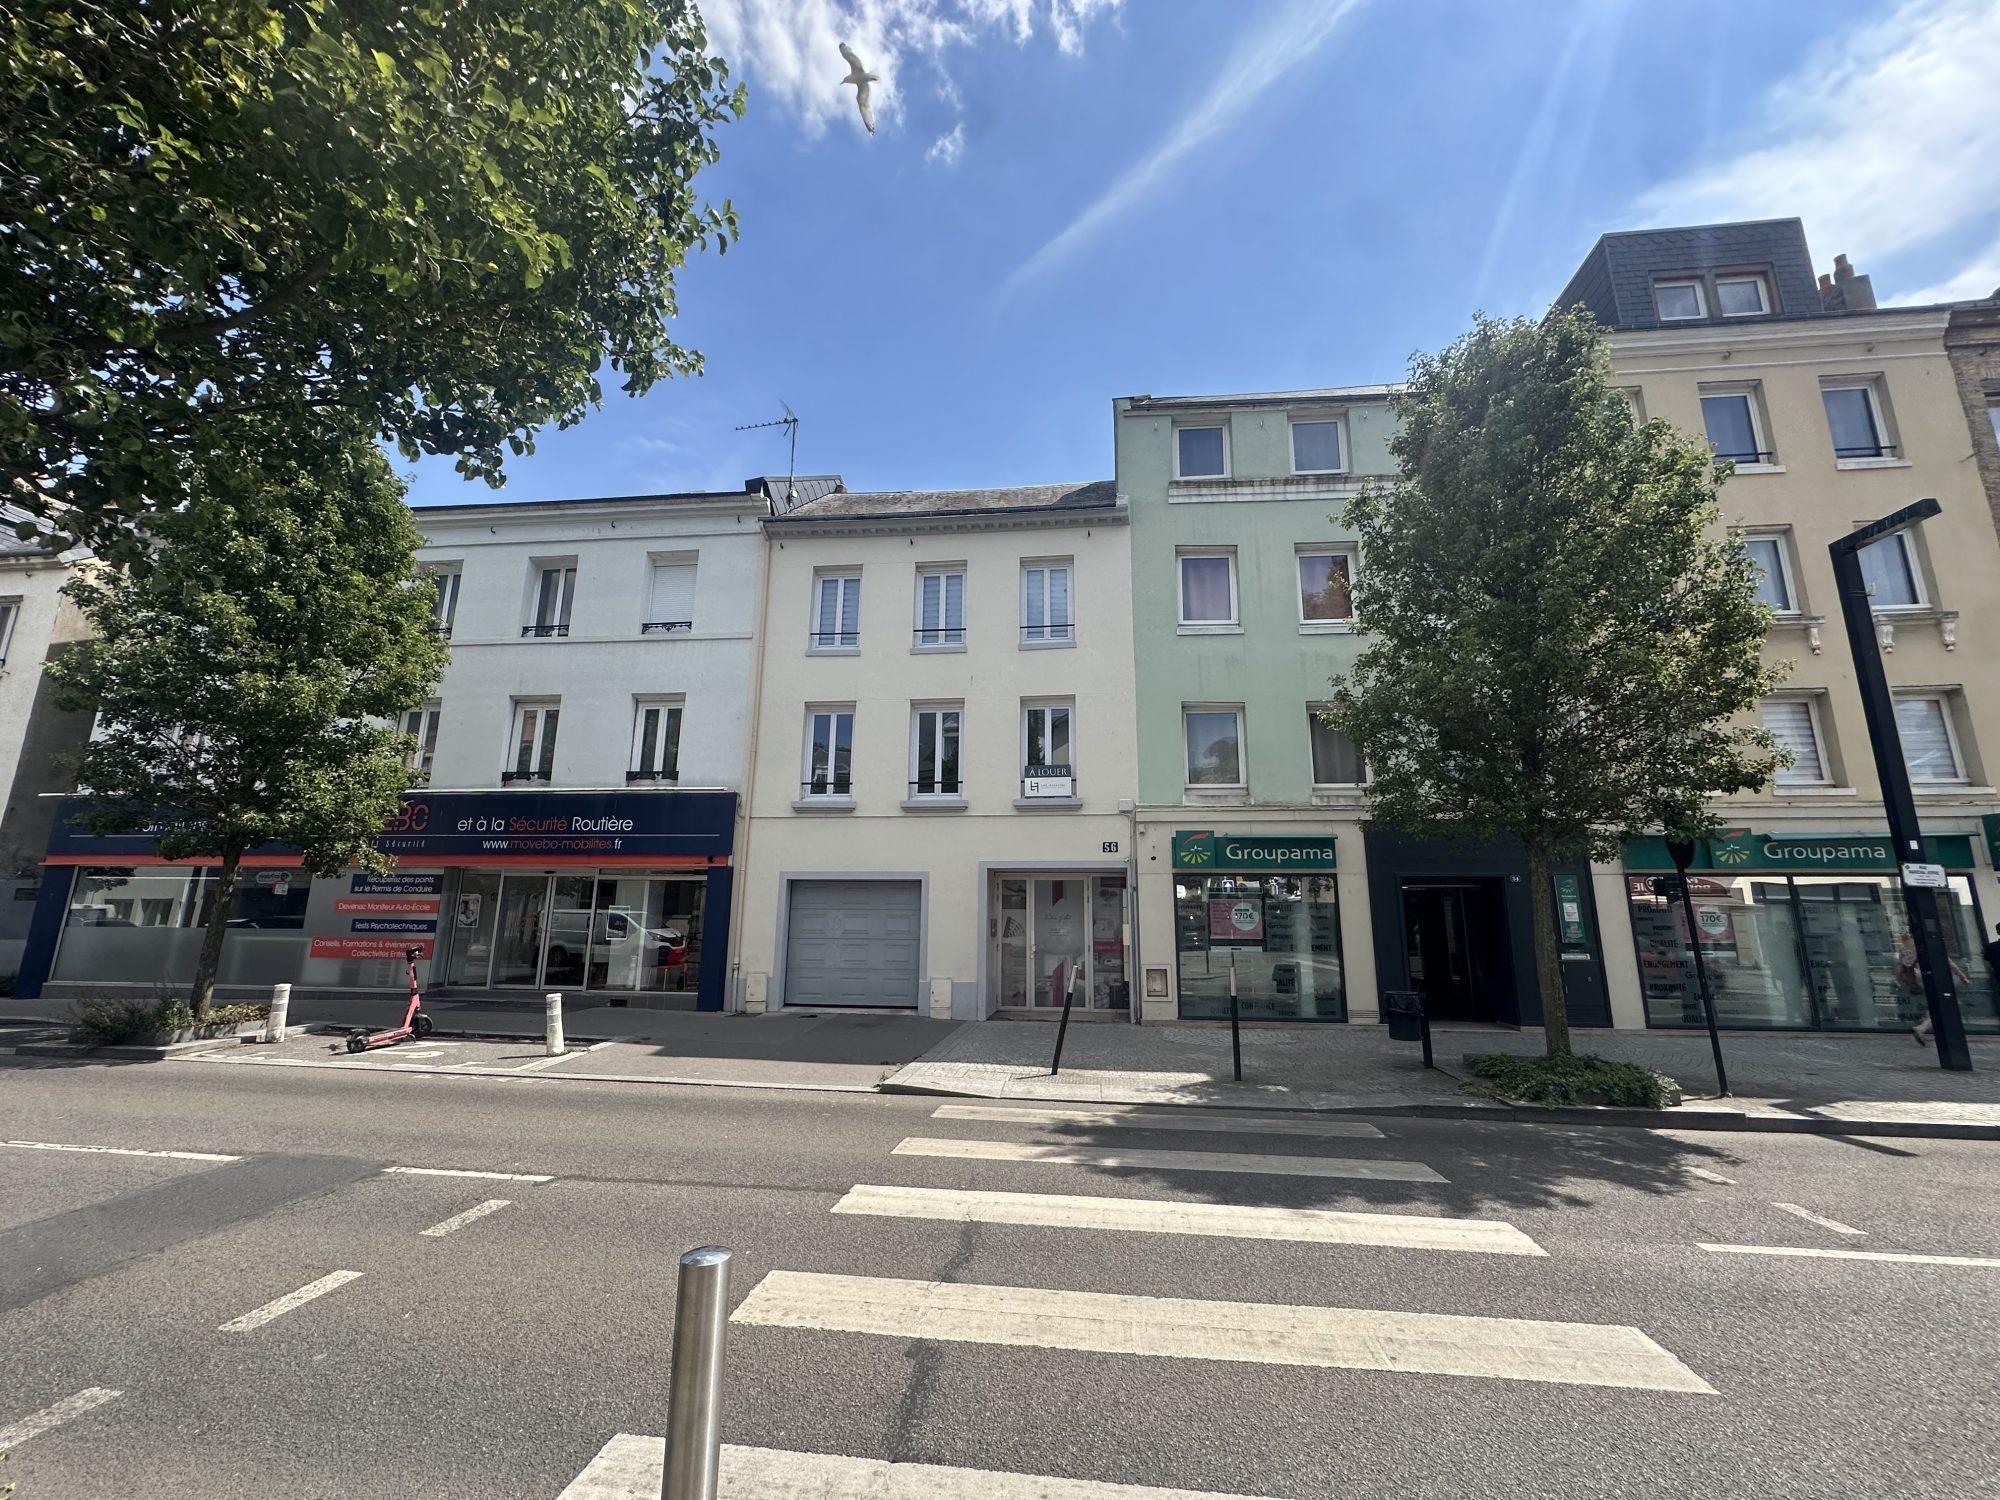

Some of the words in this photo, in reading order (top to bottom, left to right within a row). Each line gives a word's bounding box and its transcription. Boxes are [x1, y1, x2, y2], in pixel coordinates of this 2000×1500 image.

[1038, 768, 1067, 776] LOUER
[457, 818, 473, 831] et
[476, 815, 487, 831] à
[491, 817, 505, 831] la
[508, 816, 568, 831] Sécurité
[571, 816, 634, 831] Routière
[1103, 842, 1117, 852] 56
[1226, 843, 1333, 863] Groupama
[1763, 842, 1886, 862] Groupama
[401, 875, 414, 883] des
[414, 876, 435, 884] points
[403, 885, 433, 893] Conduire
[338, 902, 366, 910] Devenez
[367, 902, 395, 911] Moniteur
[1700, 915, 1722, 923] 170€
[355, 921, 370, 929] Tests
[370, 921, 428, 931] Psychotechniques
[342, 940, 378, 948] Formations
